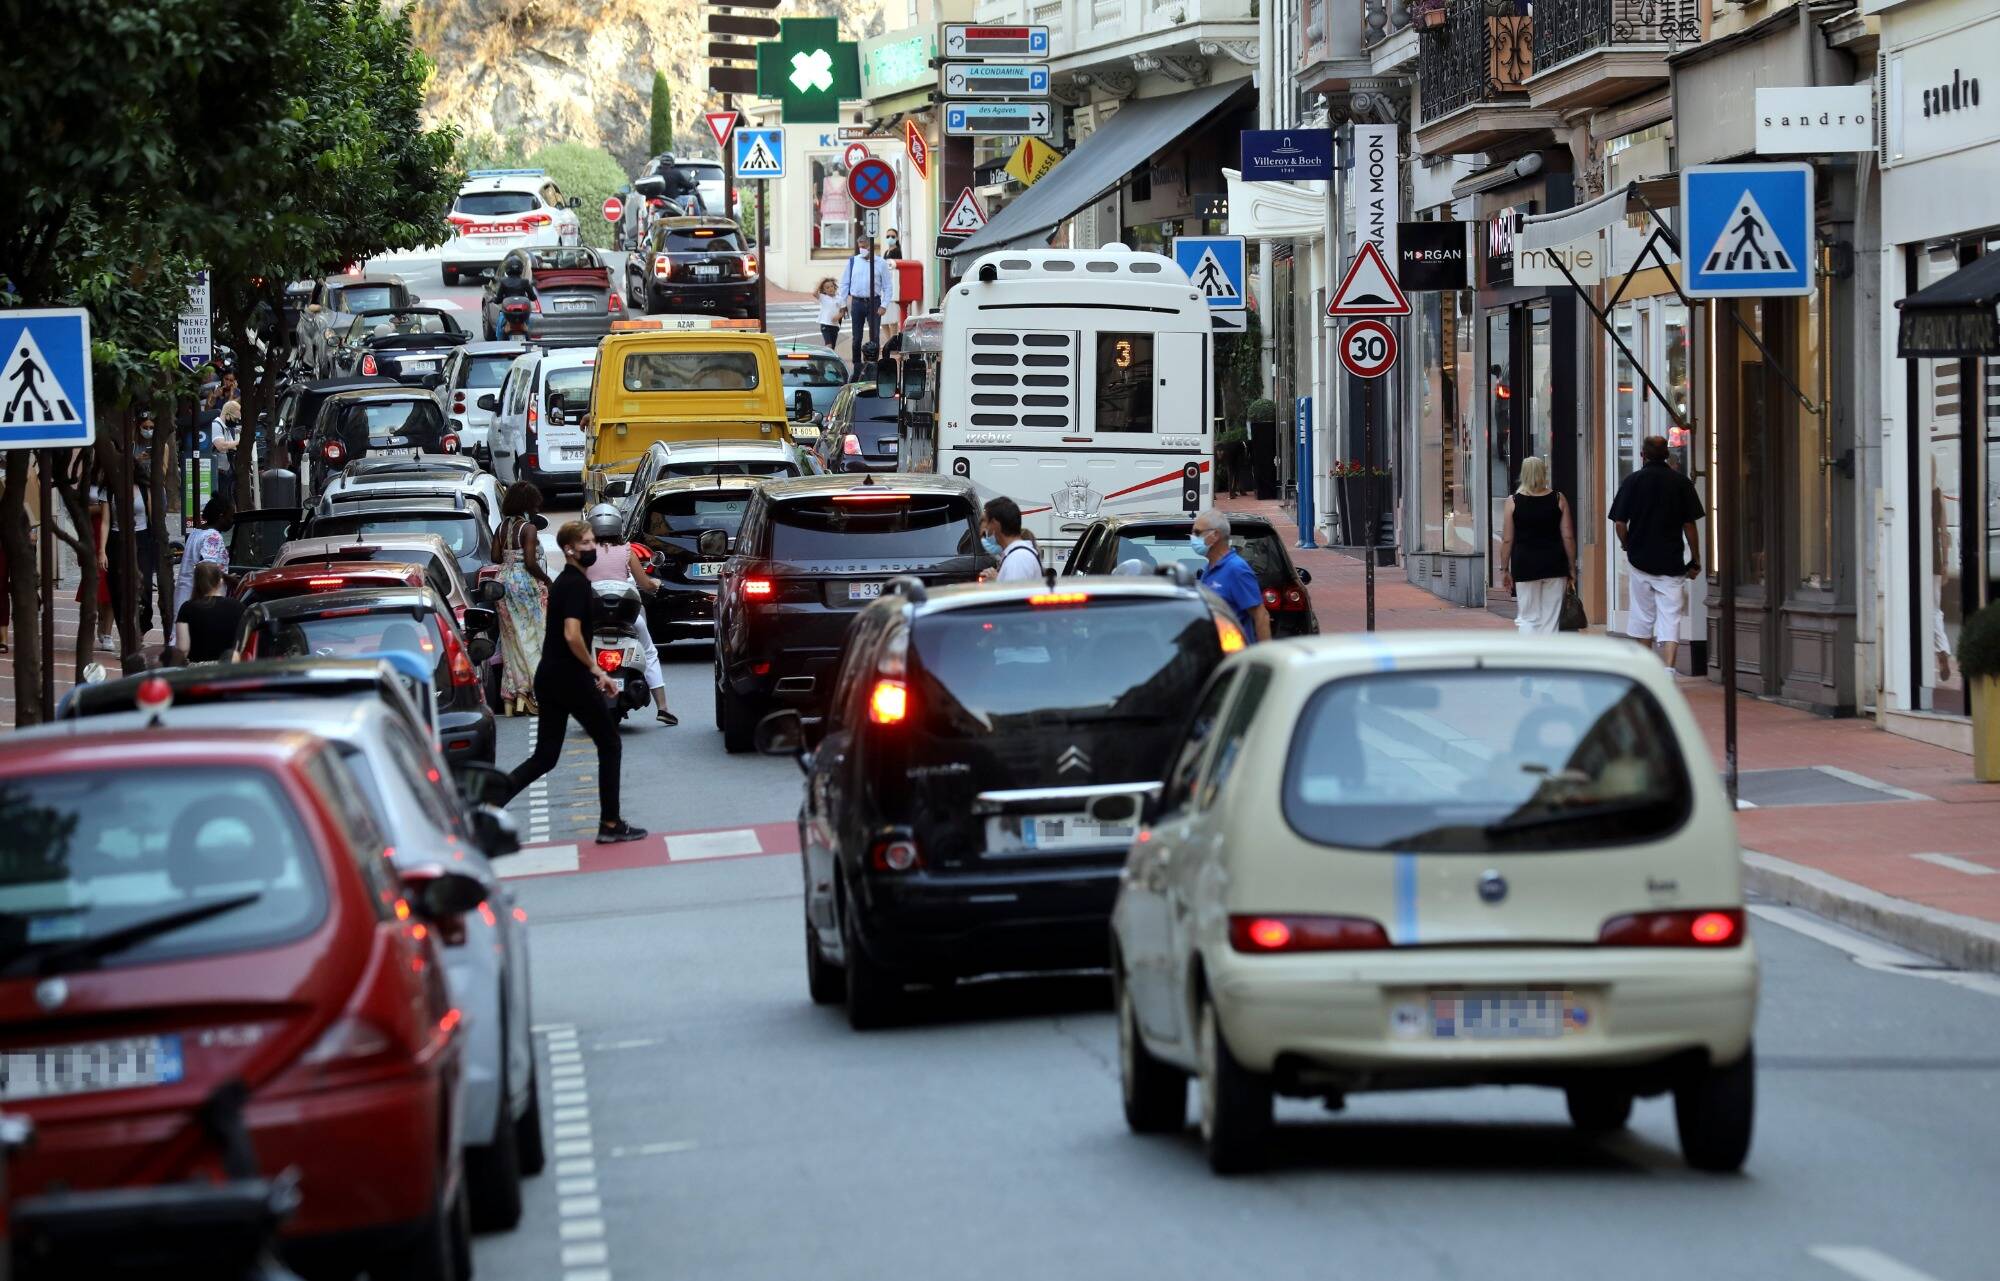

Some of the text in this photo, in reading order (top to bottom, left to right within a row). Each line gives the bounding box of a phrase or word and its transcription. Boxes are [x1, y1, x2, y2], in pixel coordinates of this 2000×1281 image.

[1034, 35, 1043, 48] P
[1034, 74, 1043, 87] P
[1923, 68, 1979, 118] sandro
[952, 112, 961, 125] P
[992, 107, 1016, 115] Agaves
[1764, 112, 1865, 127] sandro
[1253, 156, 1322, 167] Villeroy & Boch
[1369, 135, 1384, 193] MOON
[469, 225, 523, 233] POLICE
[1370, 198, 1385, 258] NANA
[1521, 245, 1593, 272] maje
[677, 320, 695, 329] AZAR
[183, 327, 206, 336] VOTRE
[182, 336, 208, 344] TICKET
[189, 346, 201, 354] ICI
[1115, 340, 1131, 368] 3
[1352, 336, 1386, 361] 30
[947, 421, 958, 429] 54
[965, 431, 1012, 444] irisbus
[1161, 435, 1201, 447] IVECO
[700, 563, 724, 575] EX-2
[810, 563, 938, 573] RANGE ROVER
